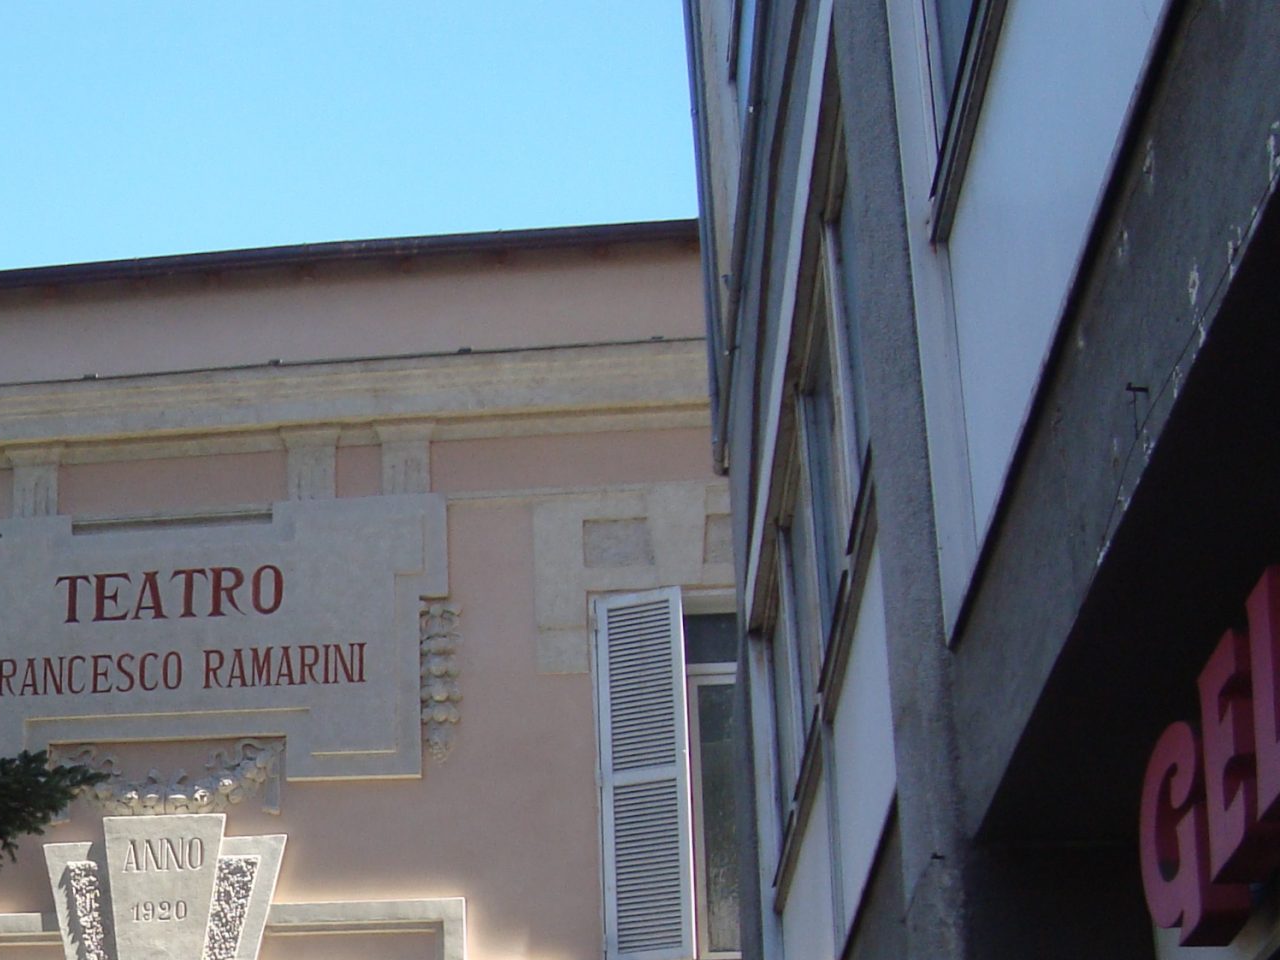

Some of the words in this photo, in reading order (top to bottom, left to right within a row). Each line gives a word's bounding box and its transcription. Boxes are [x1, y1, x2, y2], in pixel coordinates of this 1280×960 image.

[54, 564, 284, 624] TEATRO
[203, 642, 367, 689] RAMARINI
[122, 837, 205, 873] ANNO
[130, 900, 188, 922] 1920
